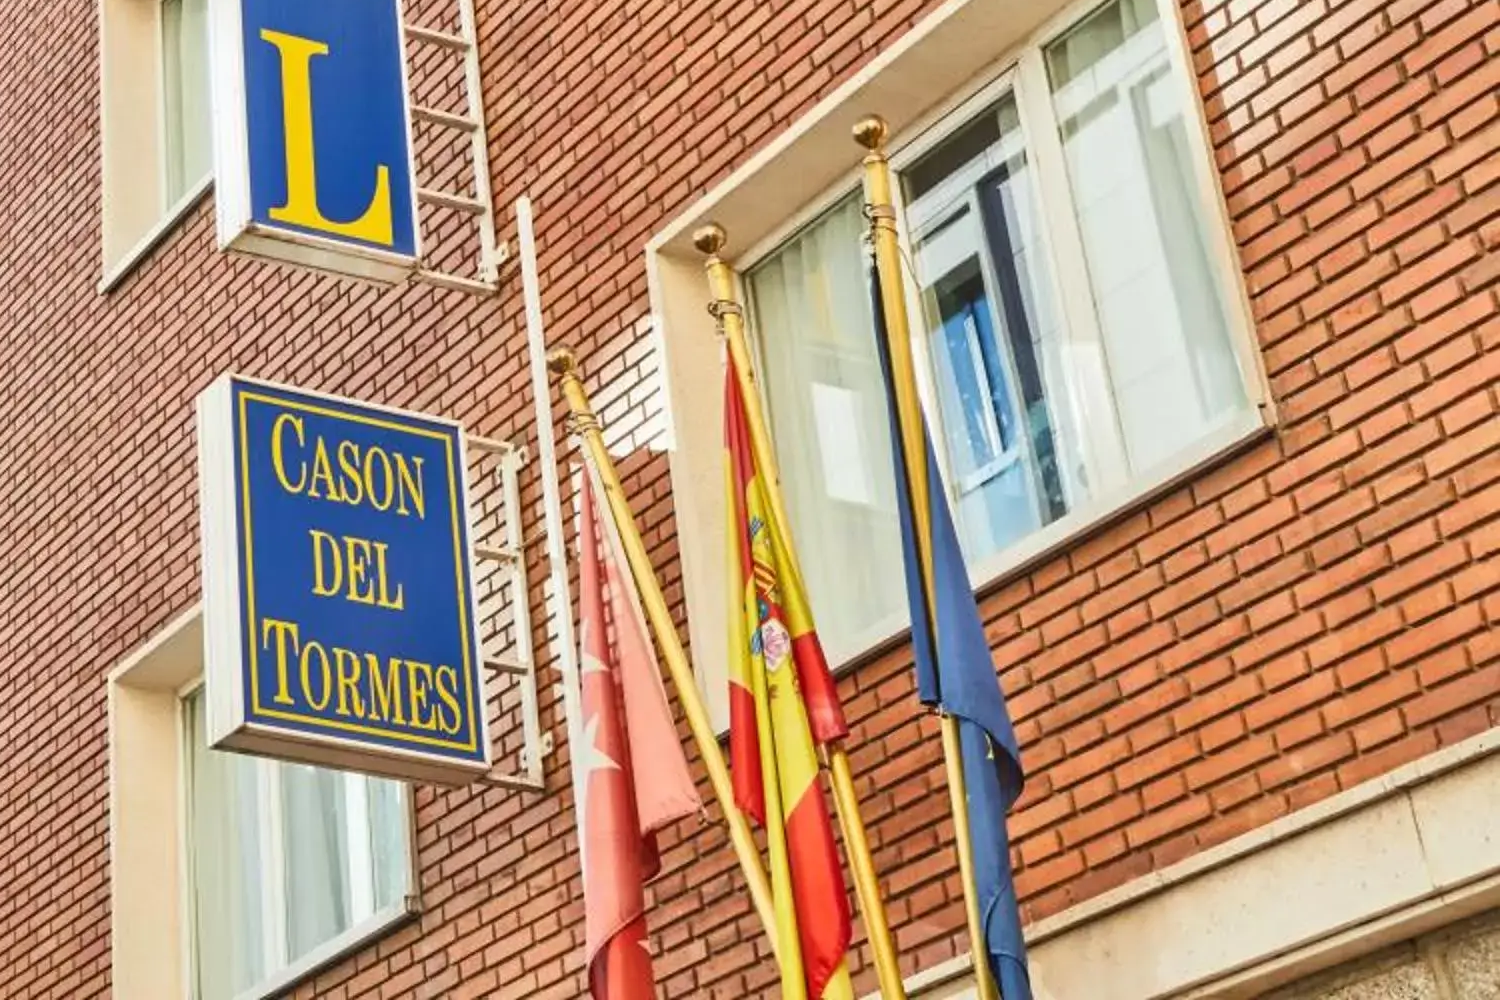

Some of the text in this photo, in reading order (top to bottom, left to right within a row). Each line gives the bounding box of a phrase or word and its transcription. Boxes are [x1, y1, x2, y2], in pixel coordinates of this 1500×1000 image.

[271, 413, 424, 520] CASON
[309, 529, 404, 610] DEL
[262, 618, 462, 735] TORMES
